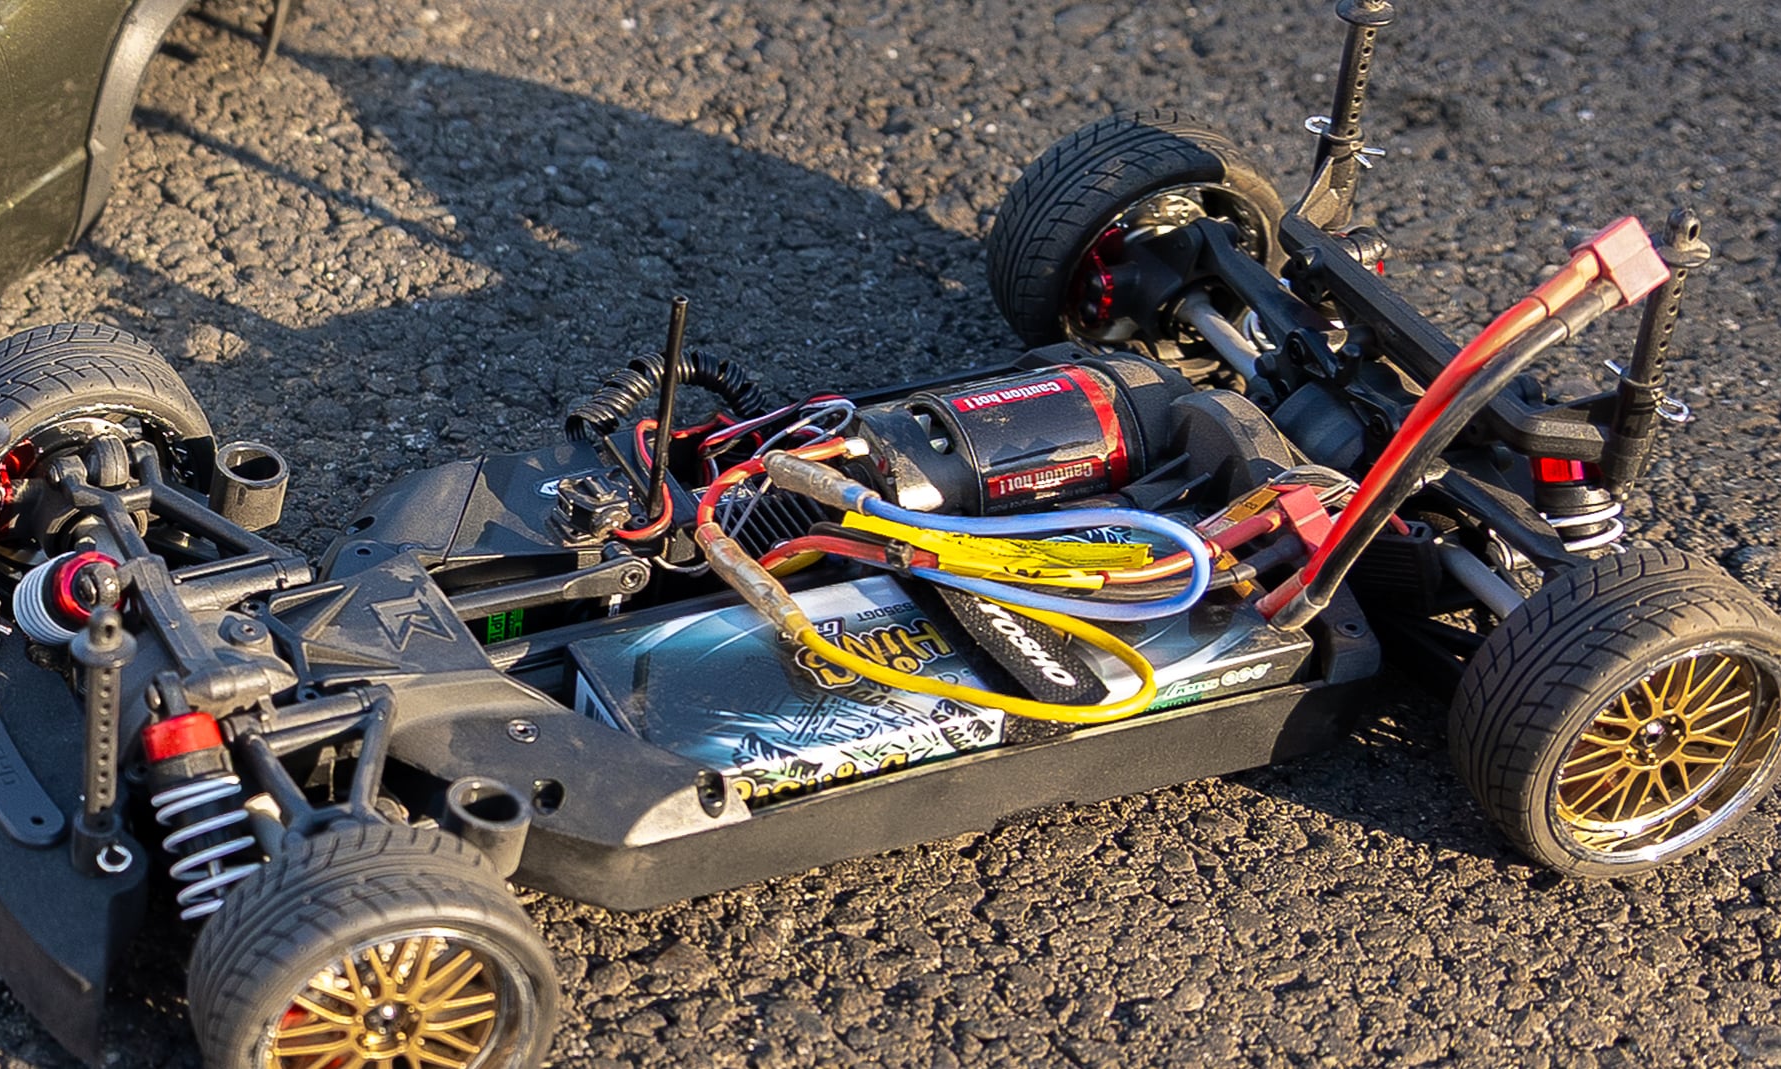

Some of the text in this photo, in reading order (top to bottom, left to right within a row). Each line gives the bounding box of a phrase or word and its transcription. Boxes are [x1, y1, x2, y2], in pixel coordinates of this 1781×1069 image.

[999, 380, 1061, 402] Caution
[1032, 461, 1093, 486] Caution
[976, 604, 1076, 686] YOSHO
